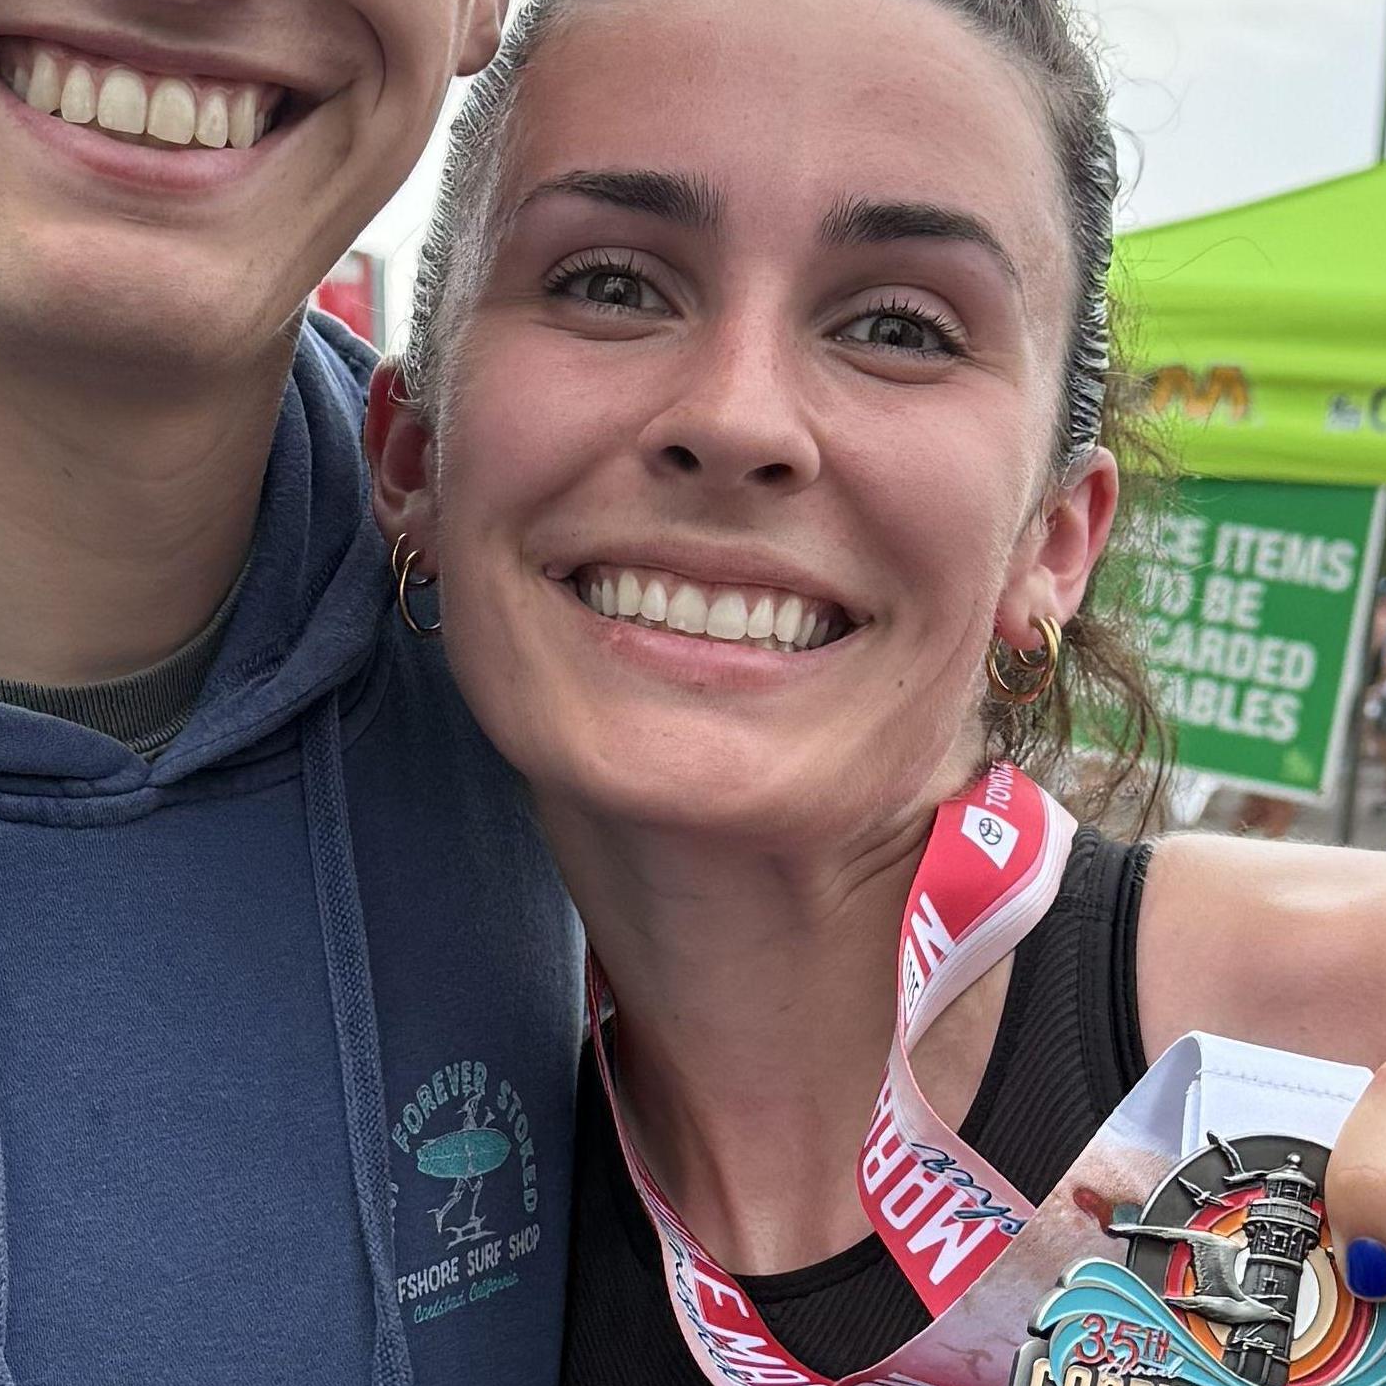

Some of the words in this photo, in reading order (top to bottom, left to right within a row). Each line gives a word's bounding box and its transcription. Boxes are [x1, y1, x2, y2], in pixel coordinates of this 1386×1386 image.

[1212, 520, 1359, 593] ITEMS
[1201, 573, 1268, 630] BE
[392, 1061, 487, 1154] FOREVER
[497, 1080, 538, 1212] STOKED
[397, 1256, 460, 1303] FSHORE
[467, 1239, 502, 1277] SURF
[508, 1223, 541, 1262] SHOP
[1073, 1313, 1171, 1372] 35TH
